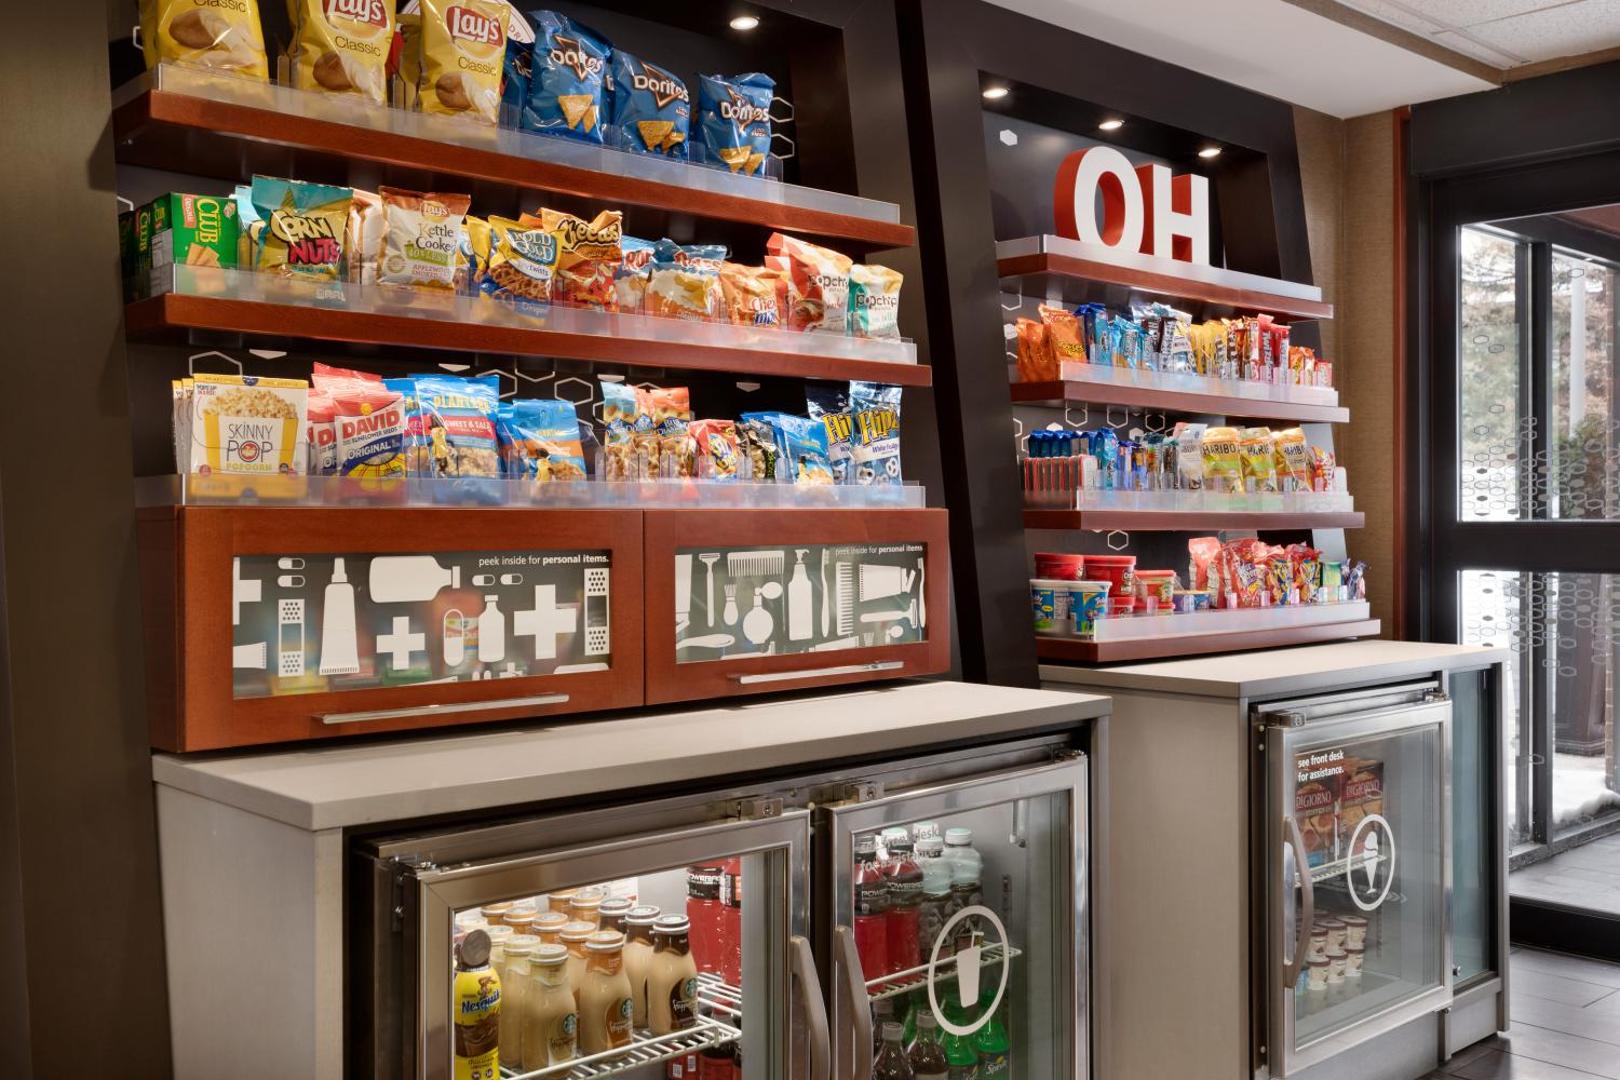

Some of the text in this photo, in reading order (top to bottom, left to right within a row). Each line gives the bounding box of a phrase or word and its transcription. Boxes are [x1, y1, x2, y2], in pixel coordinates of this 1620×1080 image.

[451, 7, 499, 44] Lay's
[334, 34, 382, 58] Classic
[457, 55, 497, 77] Classic
[634, 74, 690, 103] Doritos
[1056, 146, 1210, 266] OH
[196, 197, 221, 245] CLUB
[270, 208, 337, 243] CORN
[417, 222, 454, 238] Kettle
[287, 238, 341, 265] NUTS
[228, 422, 273, 440] SKINNY
[342, 410, 400, 440] DAVID
[857, 408, 899, 447] Flipz
[226, 440, 273, 462] POP
[347, 440, 392, 460] ORIGINAL
[1202, 443, 1236, 456] HARIBO
[226, 462, 273, 471] POPCORN
[479, 552, 609, 567] peek inside for personal items.
[879, 544, 905, 555] personal
[1297, 750, 1344, 768] see front desk
[1298, 771, 1309, 782] for
[461, 990, 500, 1014] Nesquik
